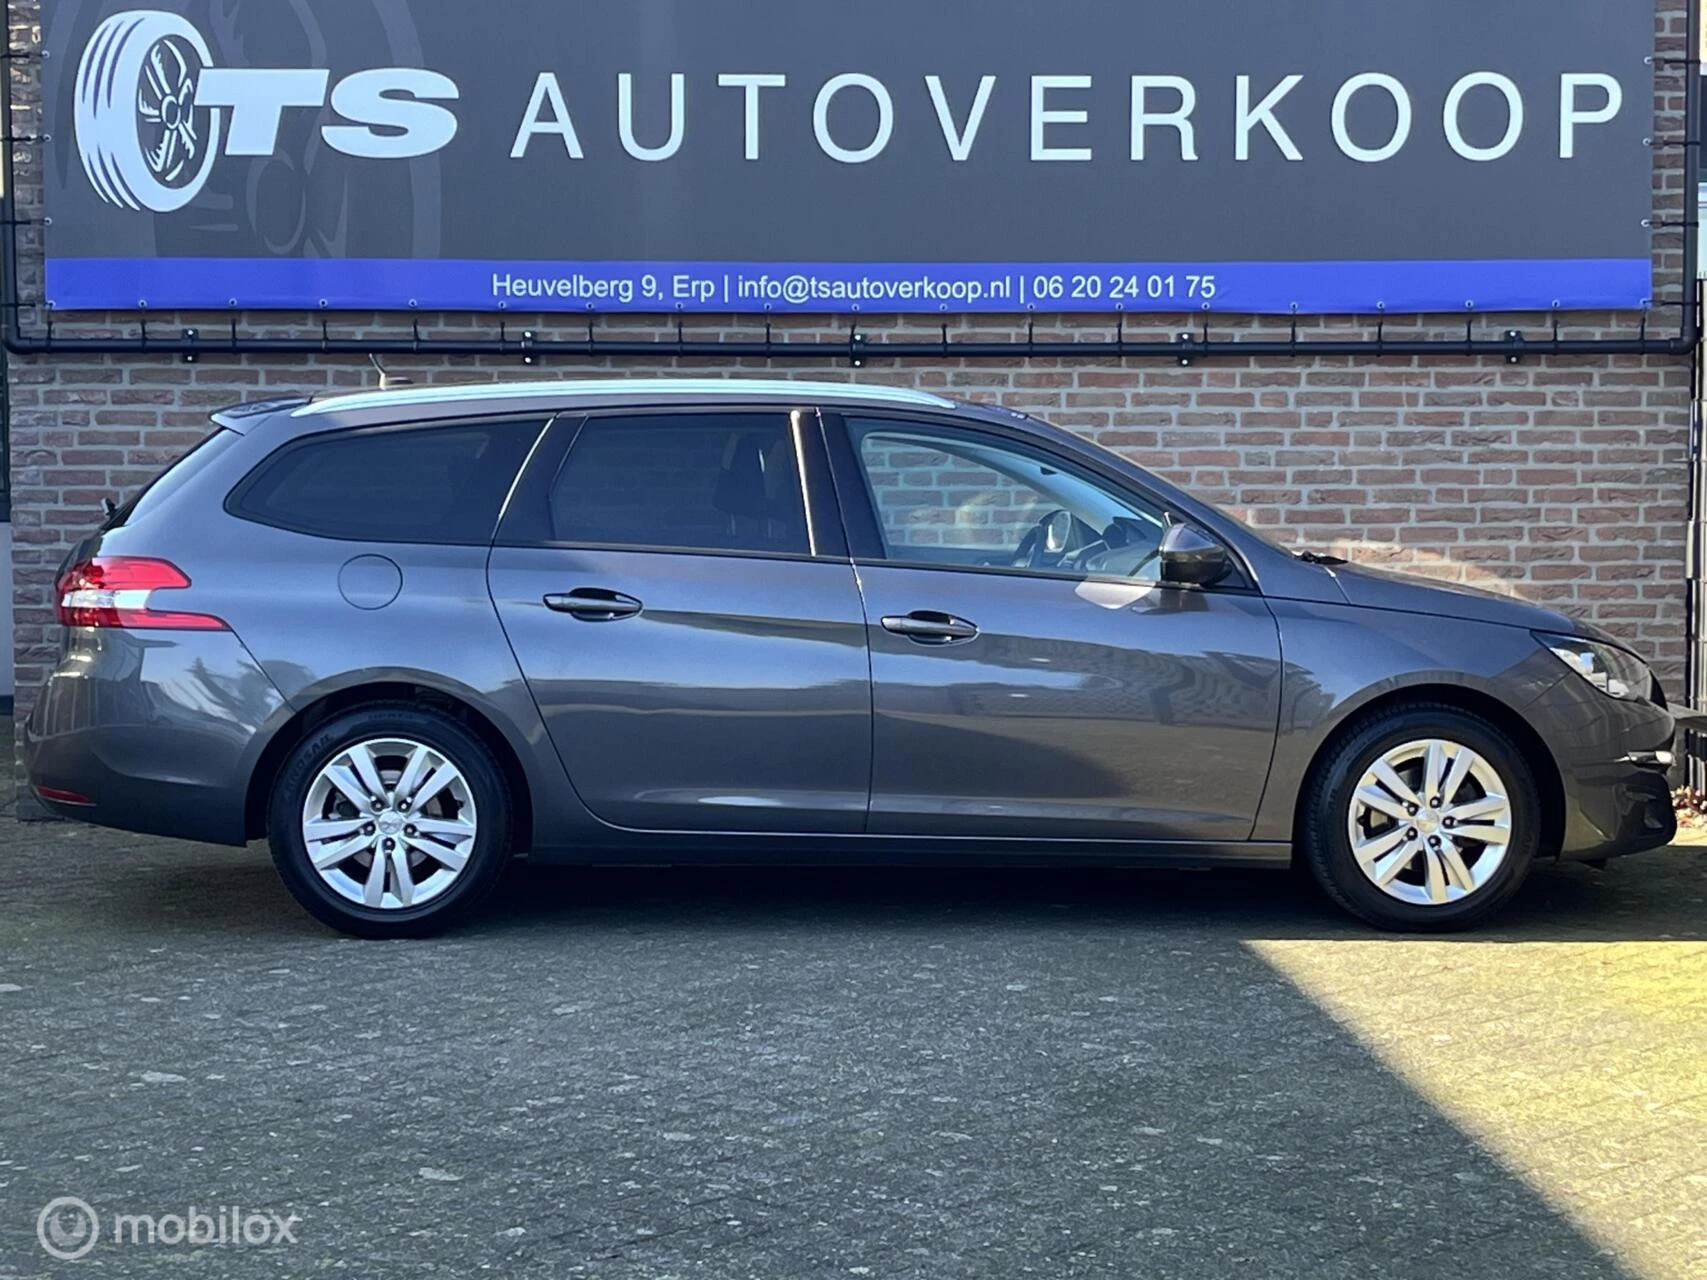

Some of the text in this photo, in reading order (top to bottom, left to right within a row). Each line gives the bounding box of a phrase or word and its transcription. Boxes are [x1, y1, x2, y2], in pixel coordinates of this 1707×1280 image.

[194, 67, 1622, 162] TS AUTOVERKOOP
[494, 274, 632, 302] Heuvelberg
[642, 275, 662, 300] 9,
[674, 276, 714, 302] Erp
[739, 276, 1009, 303] info@tsautoverkoop.nl
[1034, 276, 1063, 298] 06
[1072, 276, 1101, 297] 20
[1110, 276, 1139, 298] 24
[1148, 275, 1173, 297] 01
[1186, 276, 1215, 298] 75
